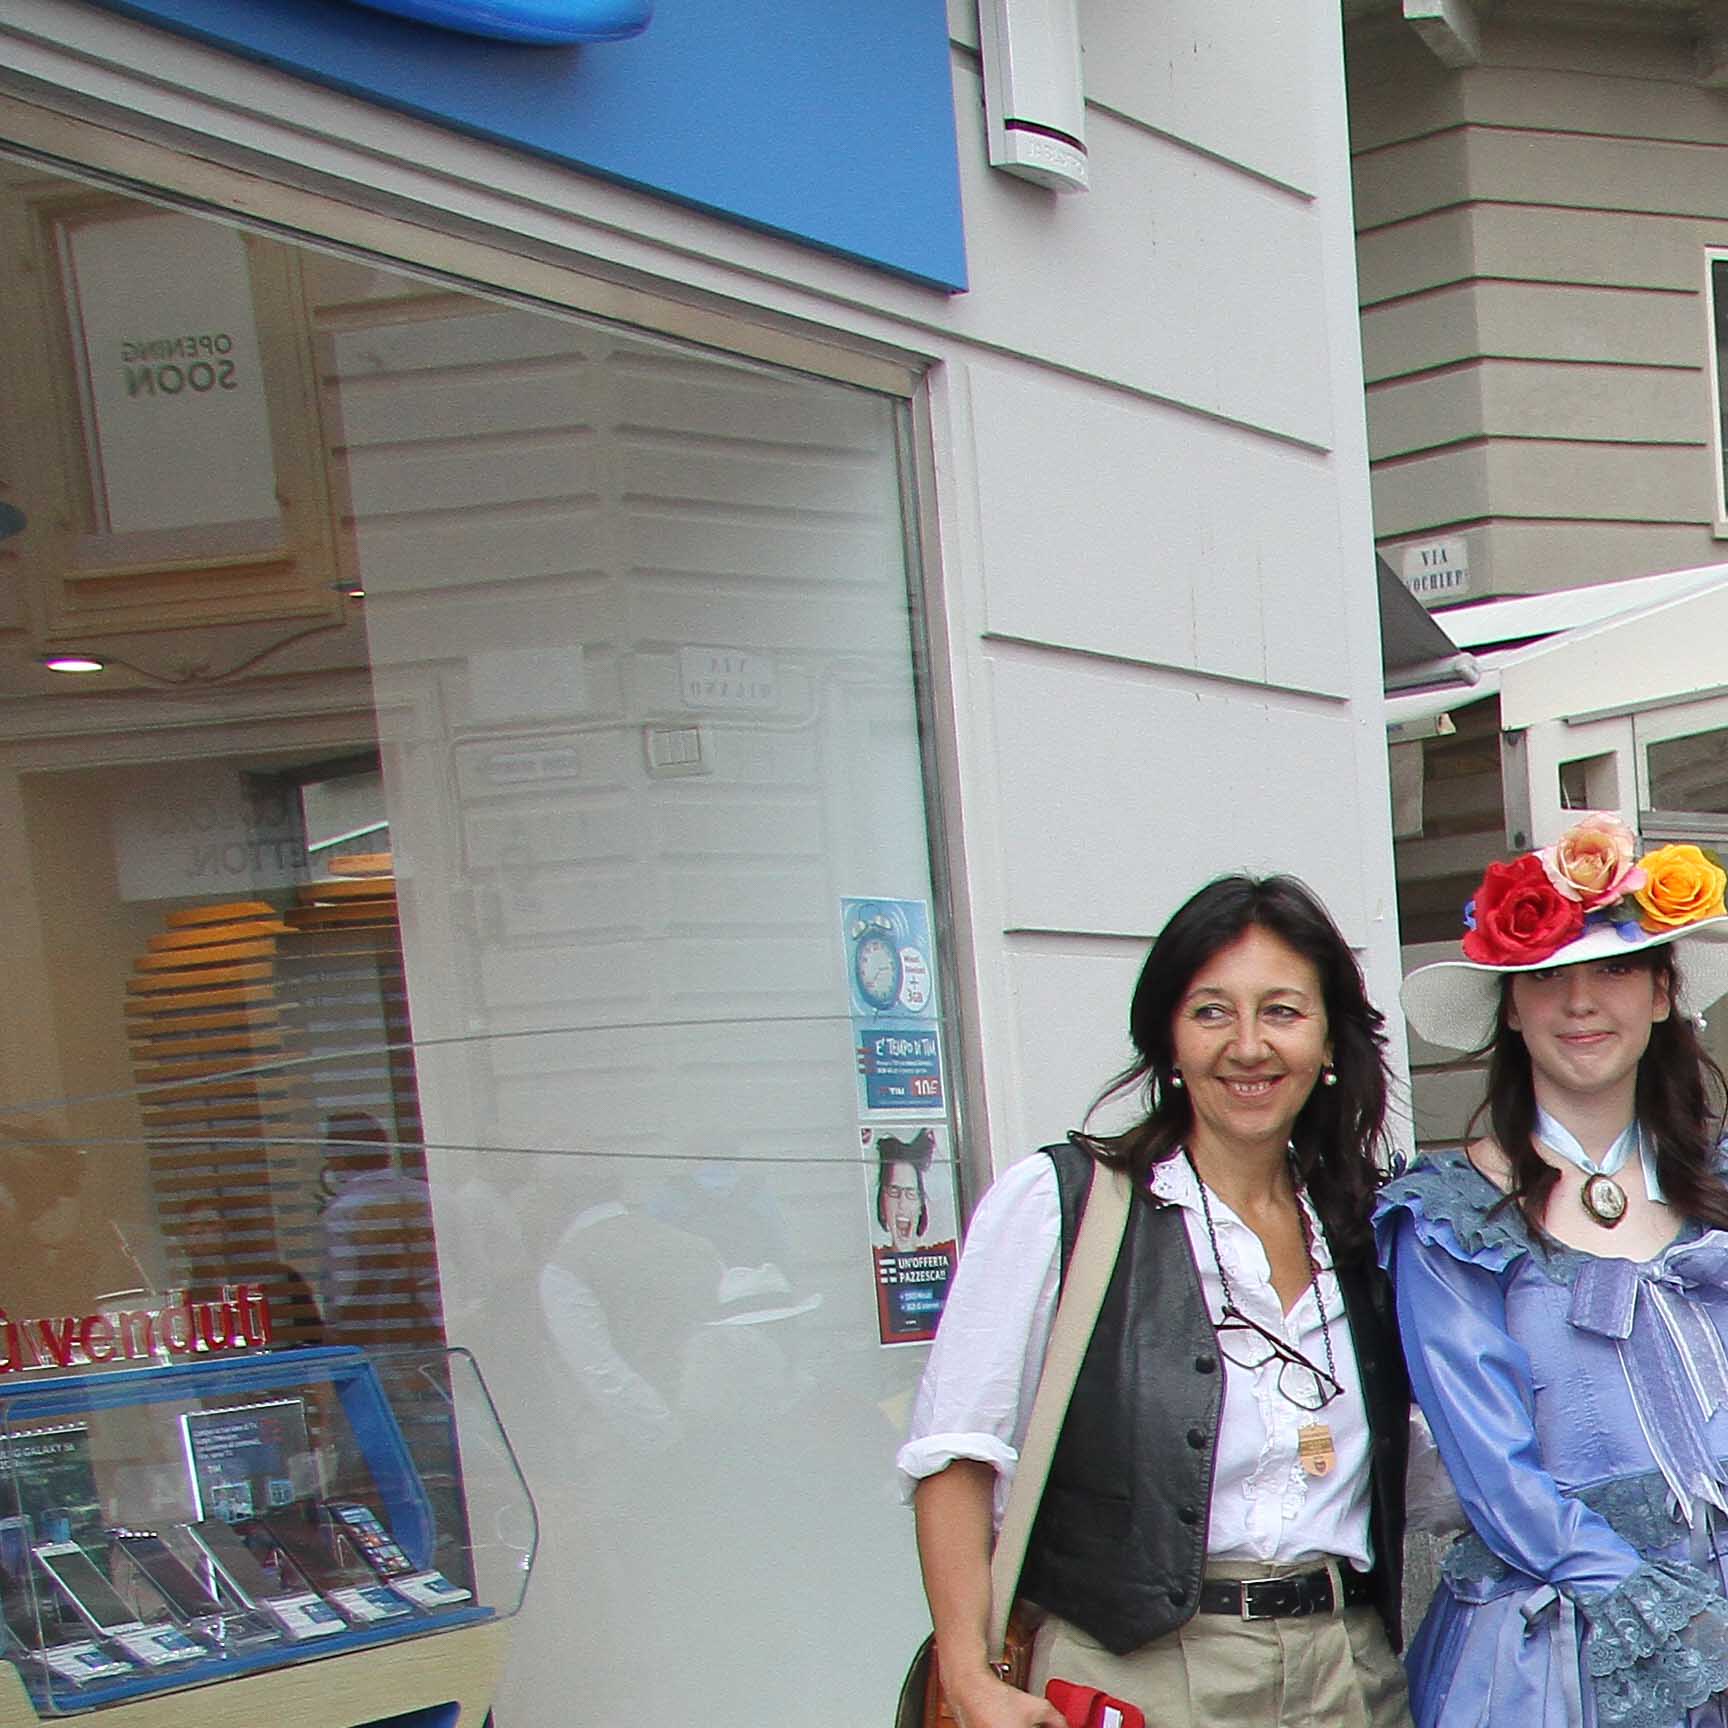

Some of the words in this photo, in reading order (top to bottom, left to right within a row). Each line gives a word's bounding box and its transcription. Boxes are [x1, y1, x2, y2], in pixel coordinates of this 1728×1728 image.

[1421, 549, 1448, 565] VIA
[898, 1255, 949, 1270] UN'OFFERTA
[38, 1283, 271, 1367] venduti
